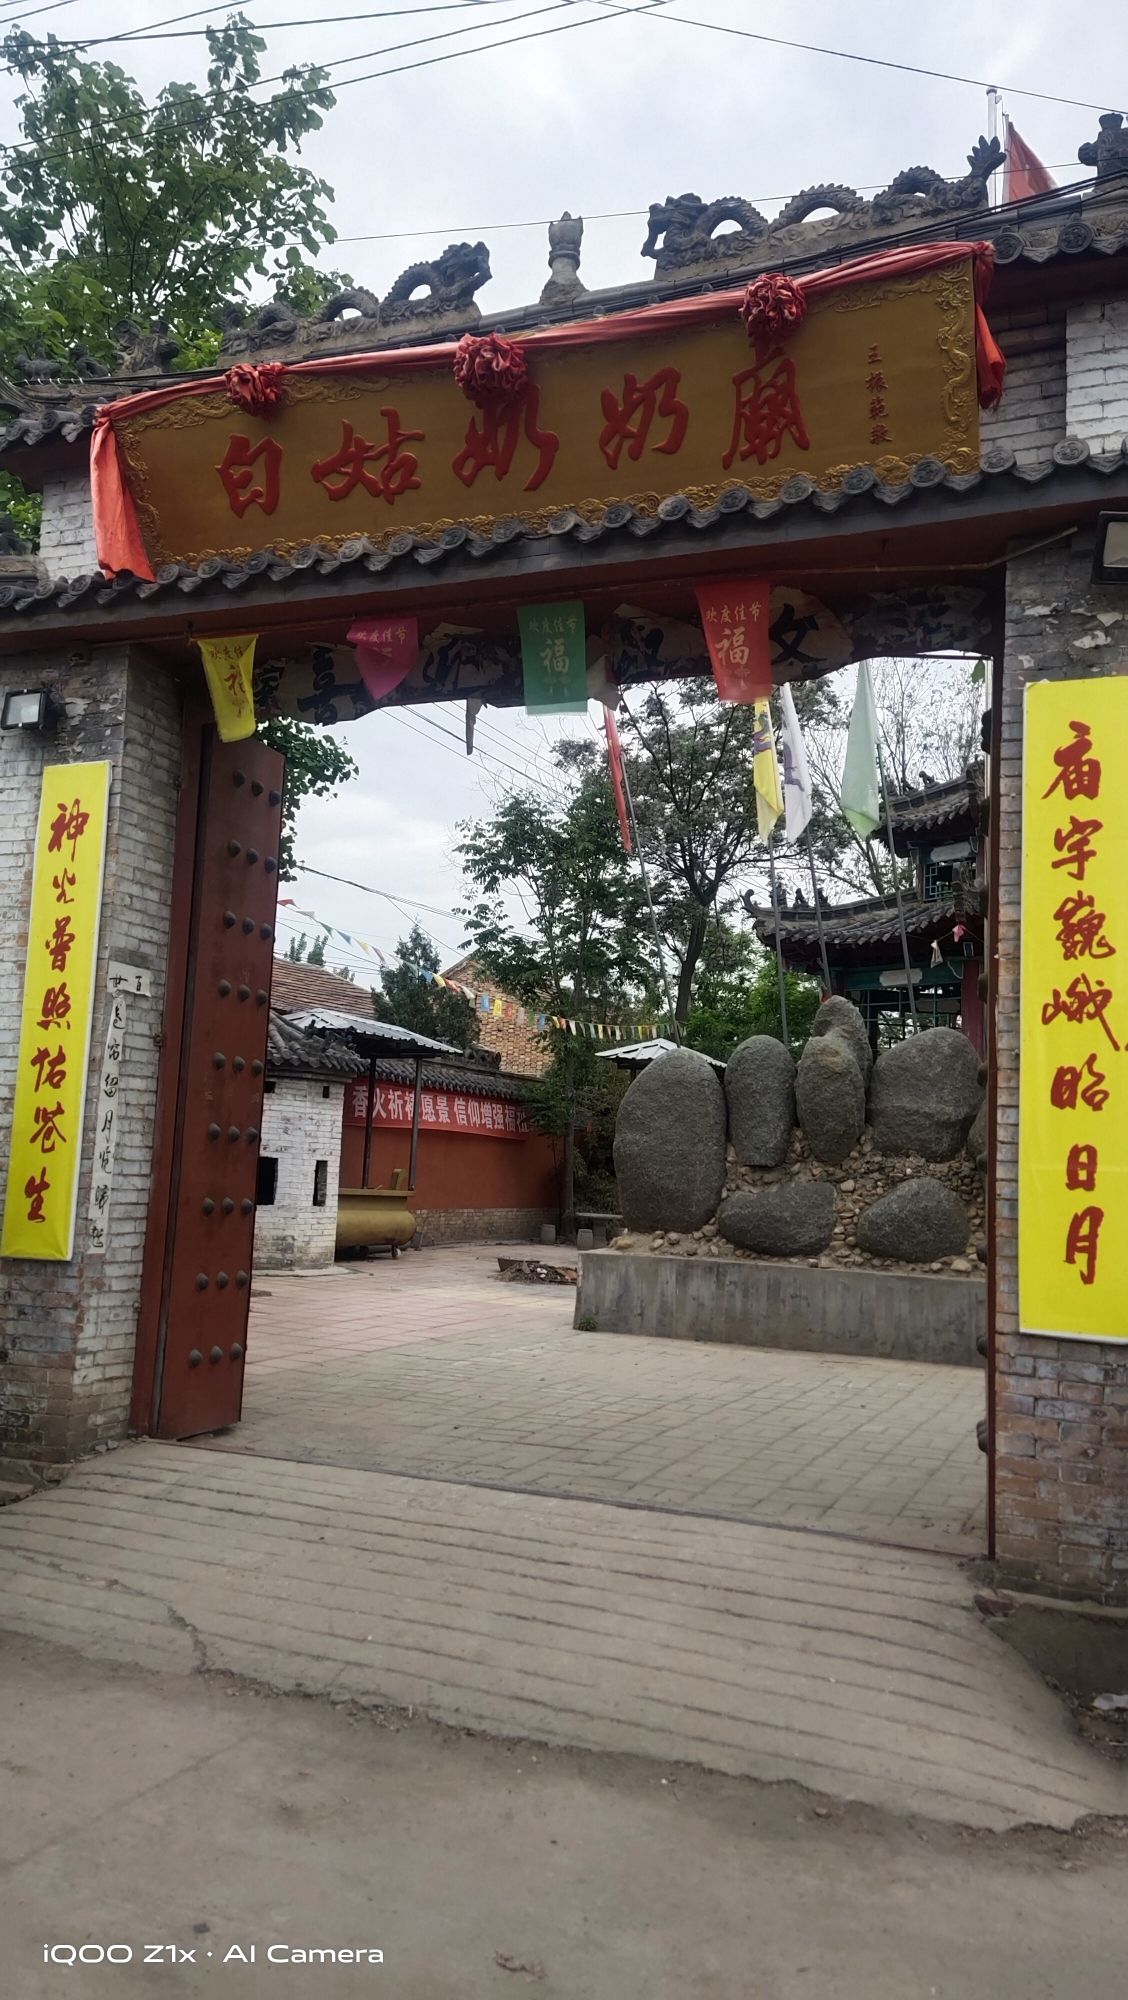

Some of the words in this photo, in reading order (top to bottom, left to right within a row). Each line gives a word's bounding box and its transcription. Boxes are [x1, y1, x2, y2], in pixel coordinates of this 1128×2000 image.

[528, 615, 578, 634] 欢度佳节
[705, 601, 762, 625] 欢度佳节
[539, 637, 570, 674] 福
[714, 626, 750, 666] 福
[1041, 720, 1120, 1286] 庙宇巍峨昭日月
